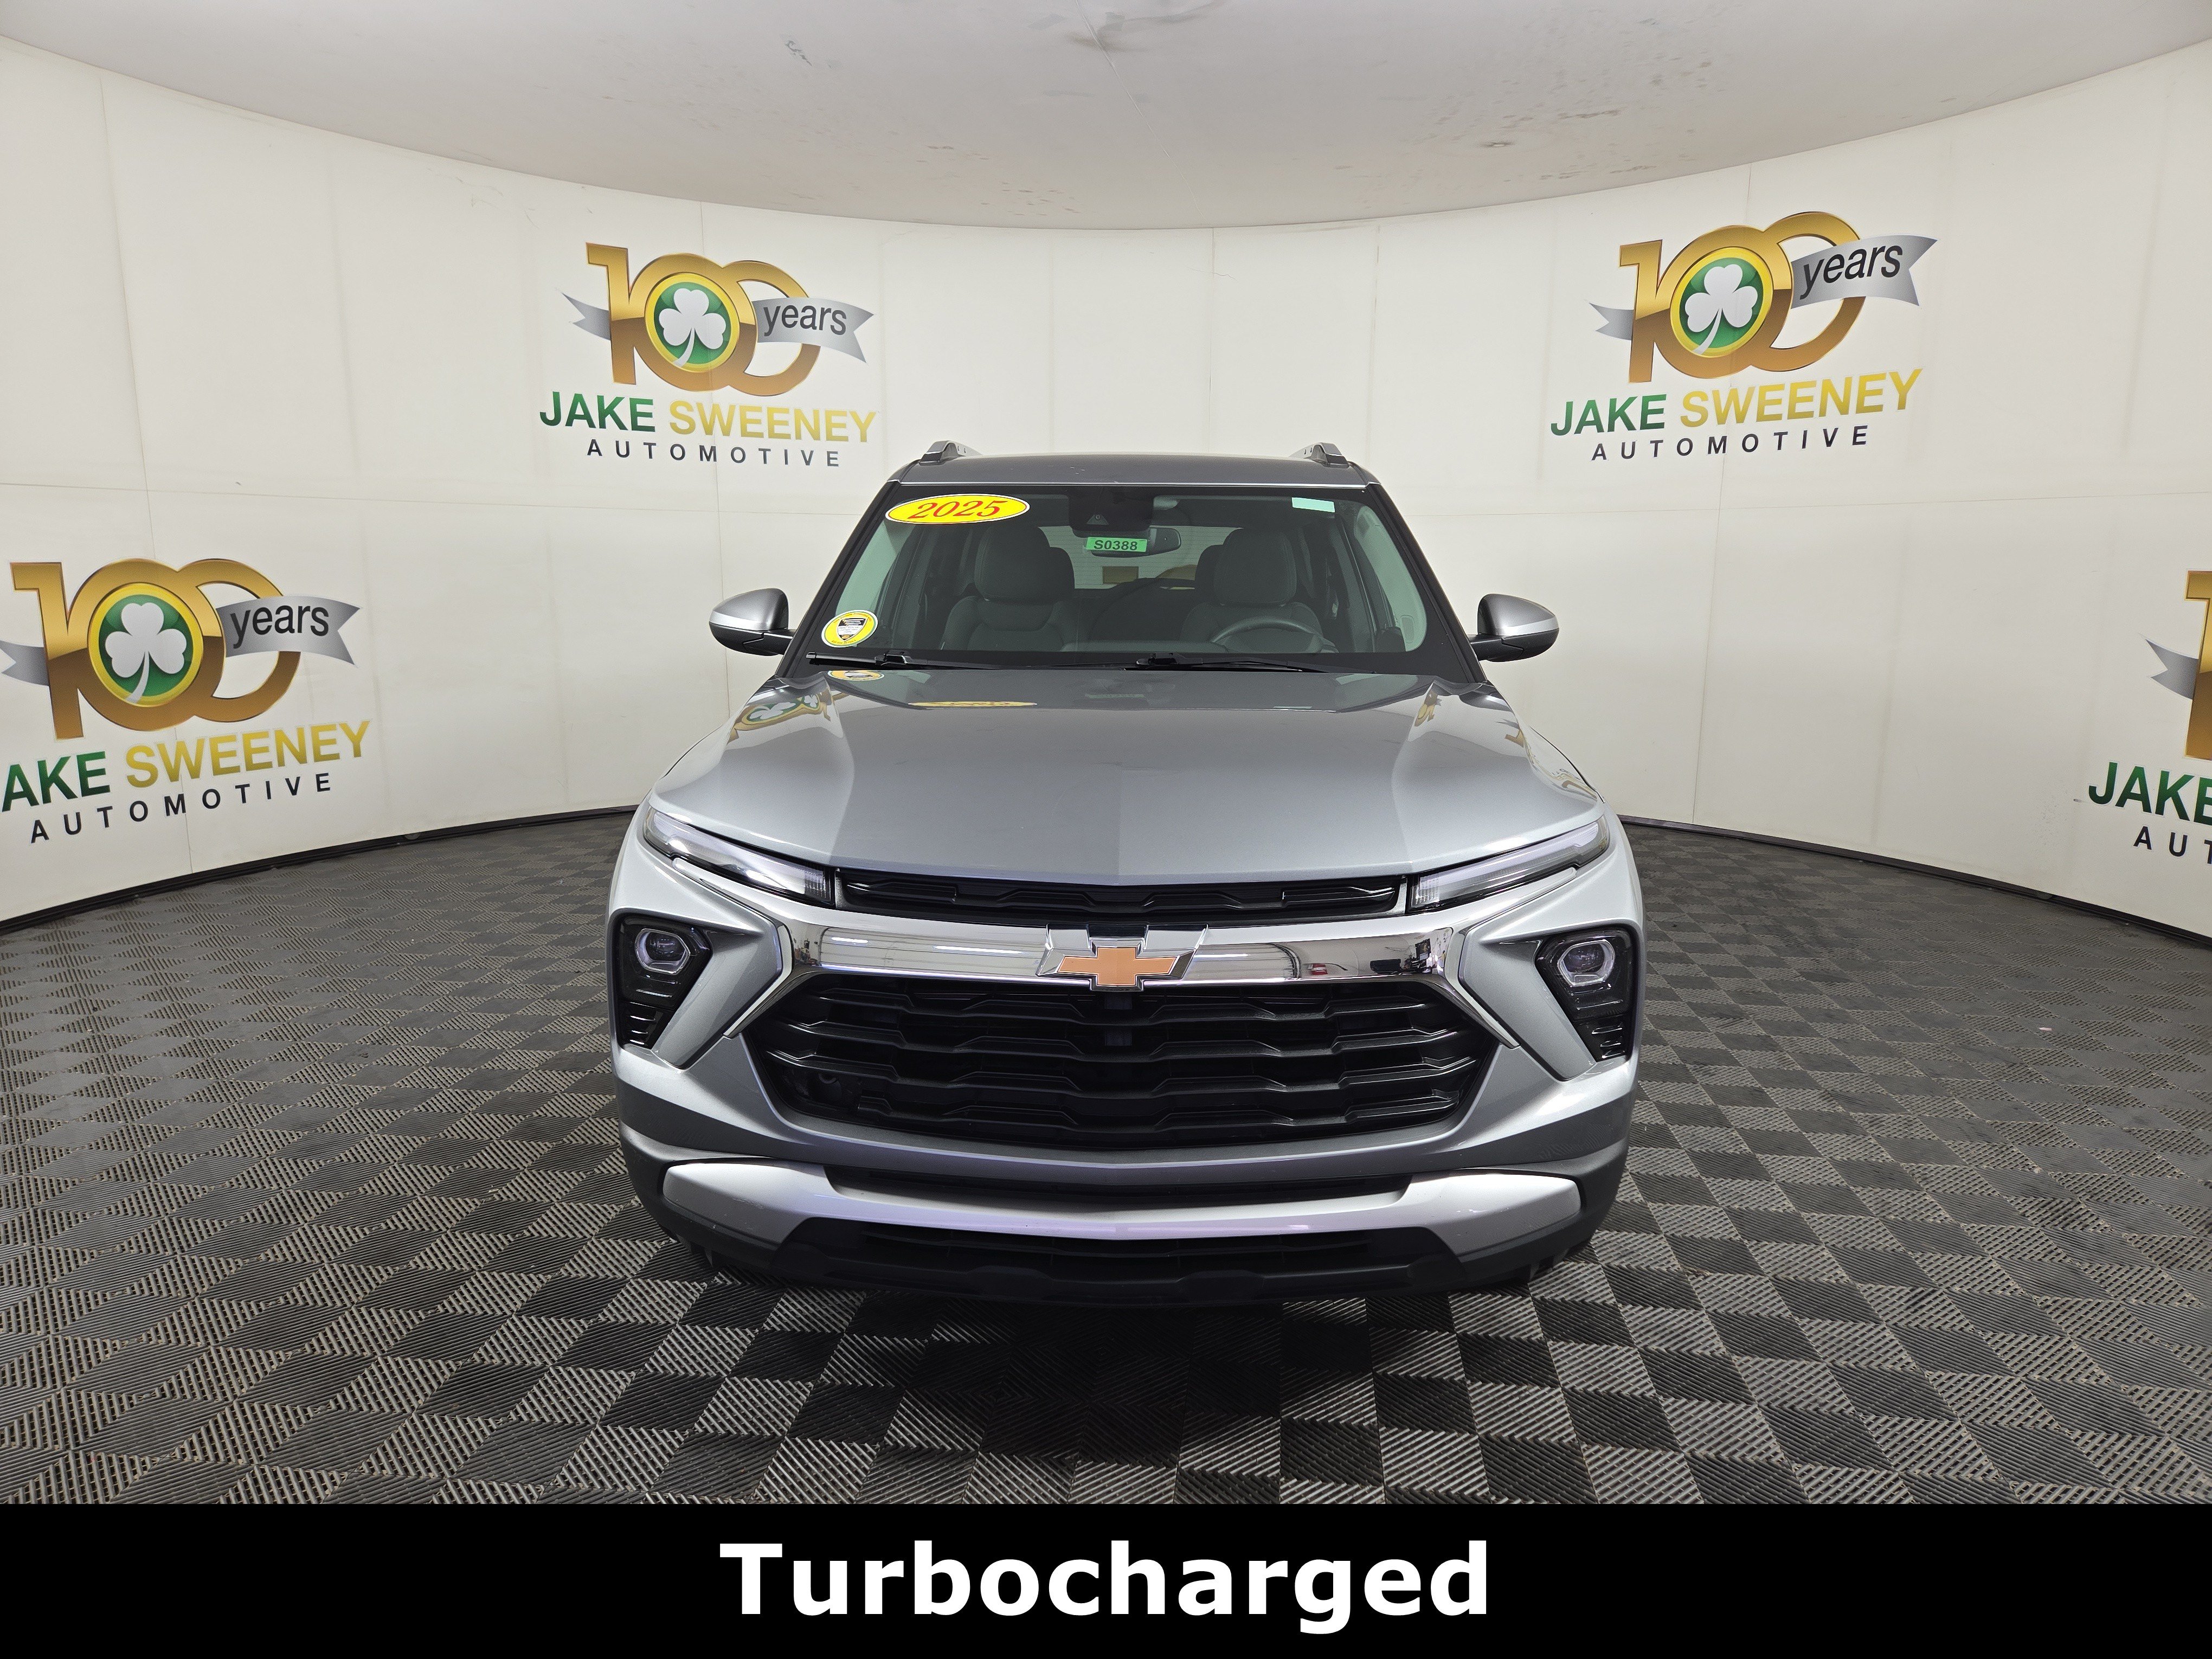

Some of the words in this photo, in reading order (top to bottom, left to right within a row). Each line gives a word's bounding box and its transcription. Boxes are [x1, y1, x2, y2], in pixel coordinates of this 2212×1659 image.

[586, 242, 821, 396] 100
[763, 305, 847, 337] years
[1619, 211, 1866, 383] 100
[1800, 245, 1903, 299] years
[540, 391, 655, 432] JAKE
[669, 400, 876, 442] SWEENEY
[1551, 394, 1667, 436] JAKE
[1680, 369, 1922, 427] SWEENEY
[587, 439, 839, 467] AUTOMOTIVE
[1592, 425, 1868, 461] AUTOMOTIVE
[907, 500, 1008, 519] 2025
[1094, 539, 1138, 551] S0388
[10, 558, 301, 740] 100
[230, 603, 329, 649] years
[125, 720, 371, 788] SWEENEY
[30, 773, 331, 844] AUTOMOTIVE
[2088, 761, 2212, 826] JAKE
